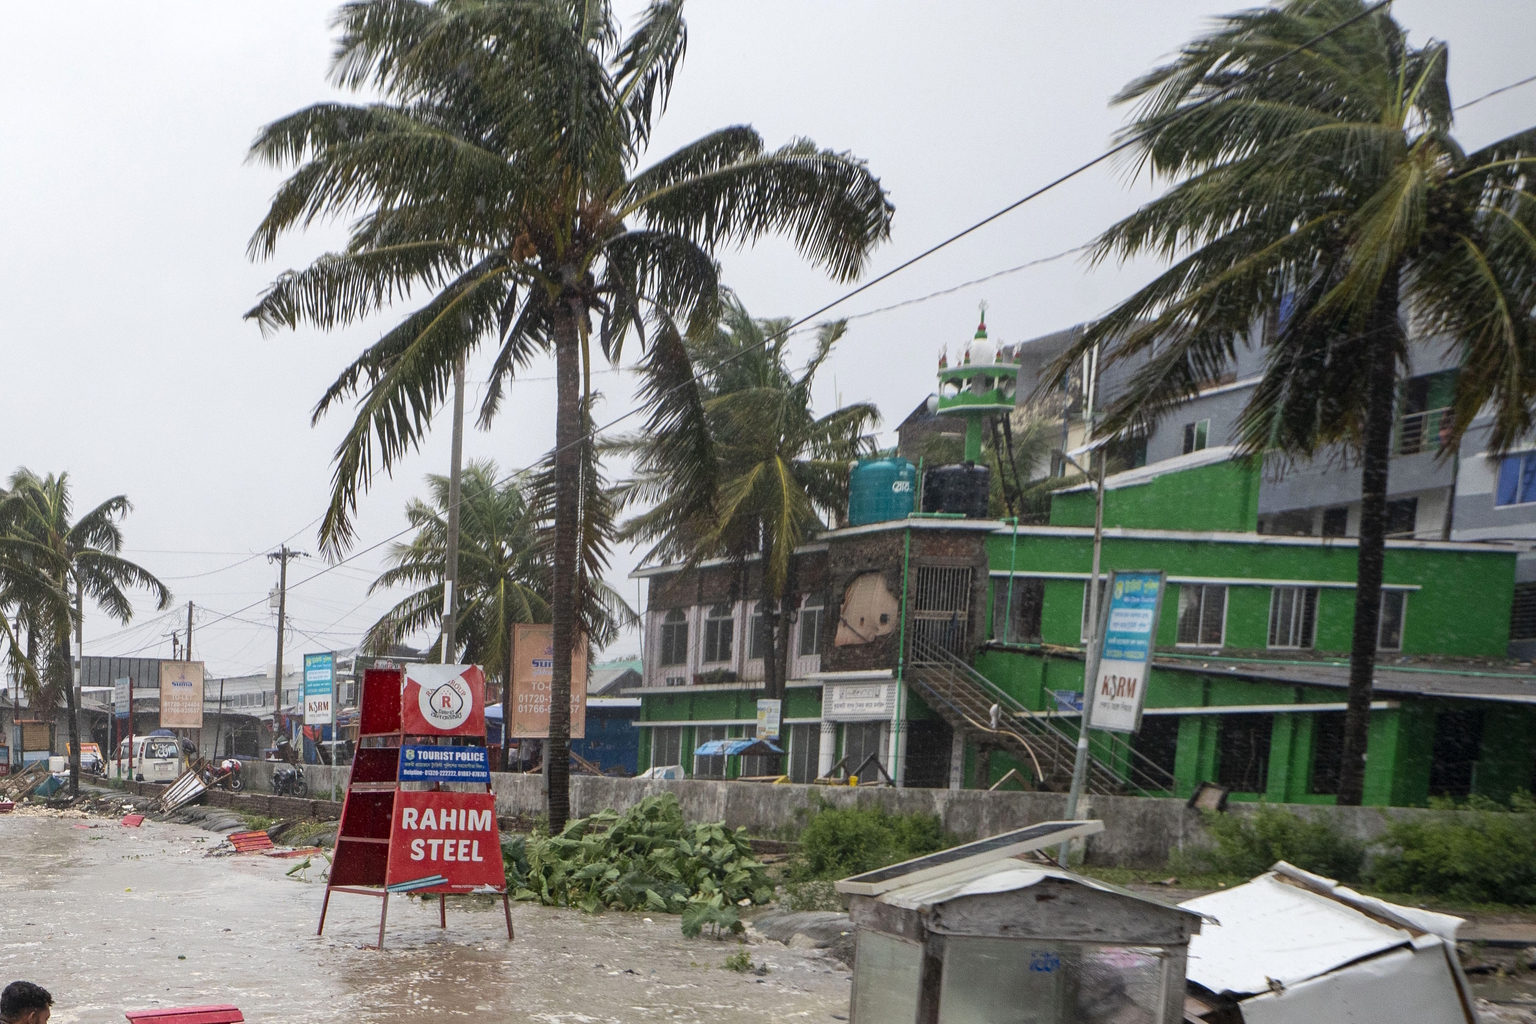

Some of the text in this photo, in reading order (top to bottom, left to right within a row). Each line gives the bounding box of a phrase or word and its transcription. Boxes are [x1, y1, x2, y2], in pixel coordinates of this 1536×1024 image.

[532, 658, 554, 668] Su
[531, 682, 552, 691] TO-
[1101, 674, 1137, 701] KSRM
[441, 695, 451, 708] R
[518, 694, 580, 704] 01720-104
[309, 701, 329, 713] KSRM
[518, 704, 580, 714] 01766-957
[417, 750, 485, 762] TOURIST POLICE
[402, 807, 492, 832] RAHIM
[410, 838, 483, 862] STEEL
